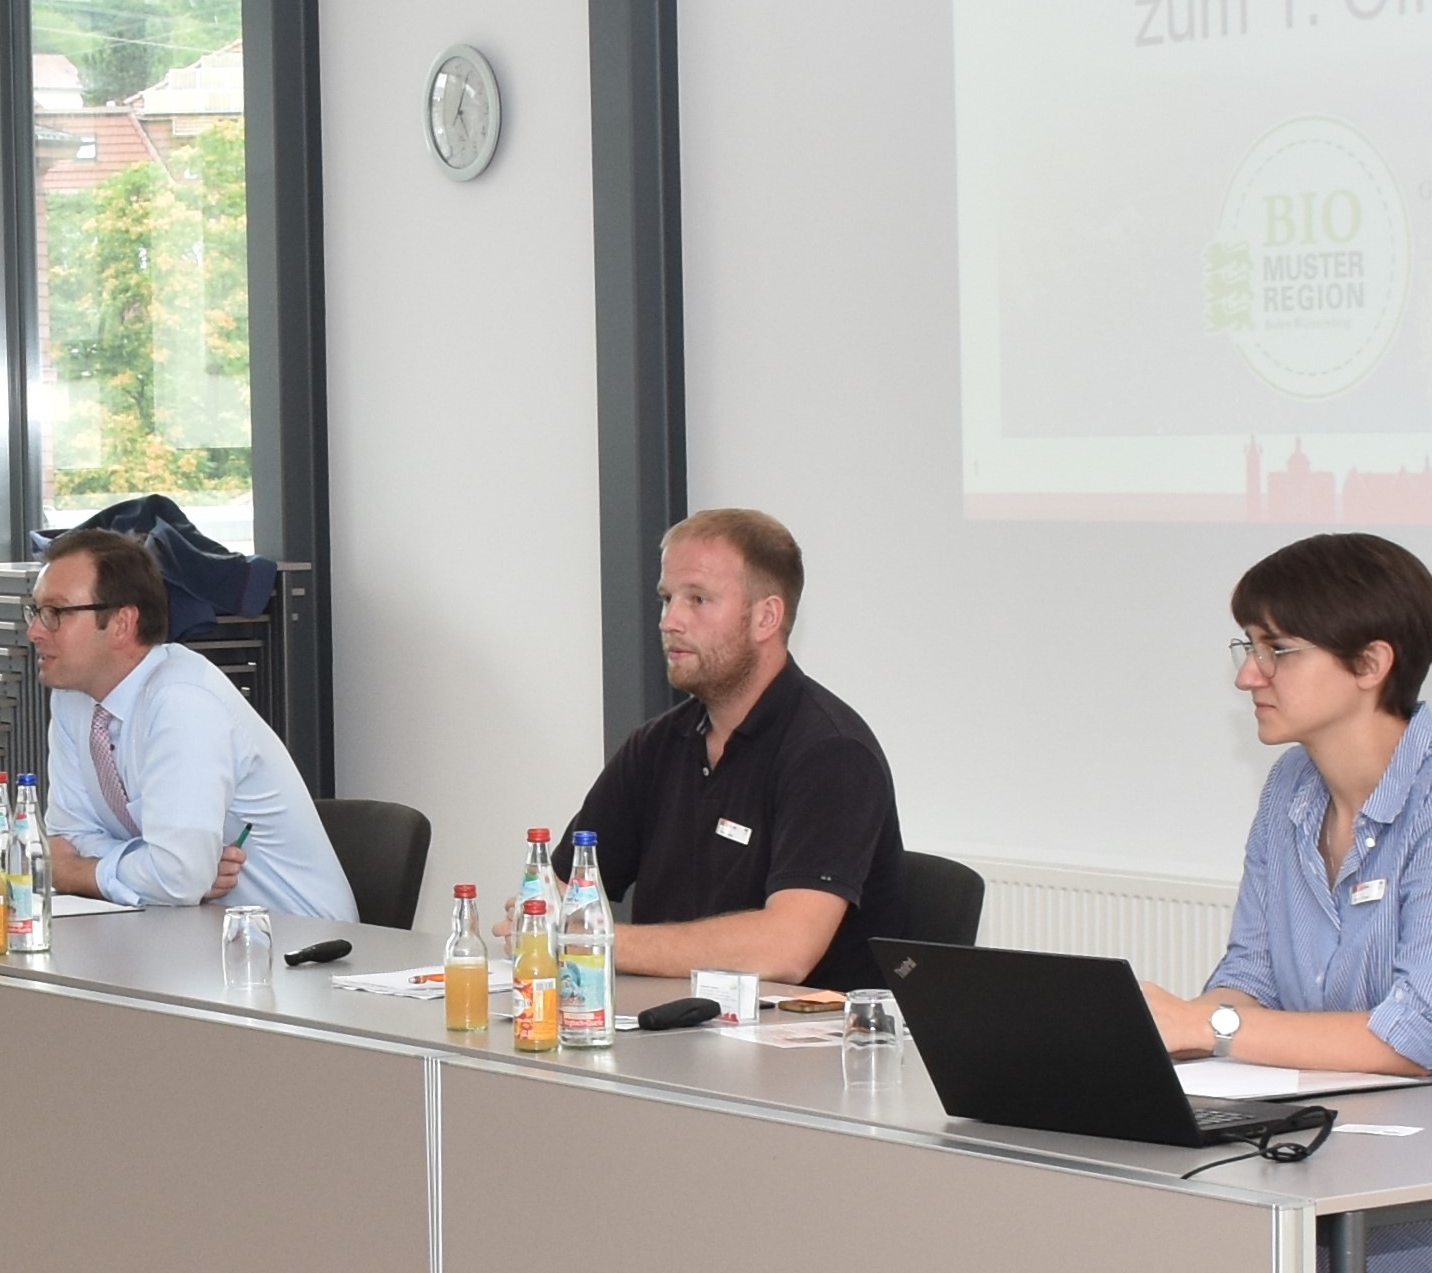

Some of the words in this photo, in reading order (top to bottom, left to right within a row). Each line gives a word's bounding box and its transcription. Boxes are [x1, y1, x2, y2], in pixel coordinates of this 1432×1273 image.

[1261, 188, 1363, 248] BIO
[1262, 249, 1366, 282] MUSTER
[1262, 281, 1366, 313] REGION
